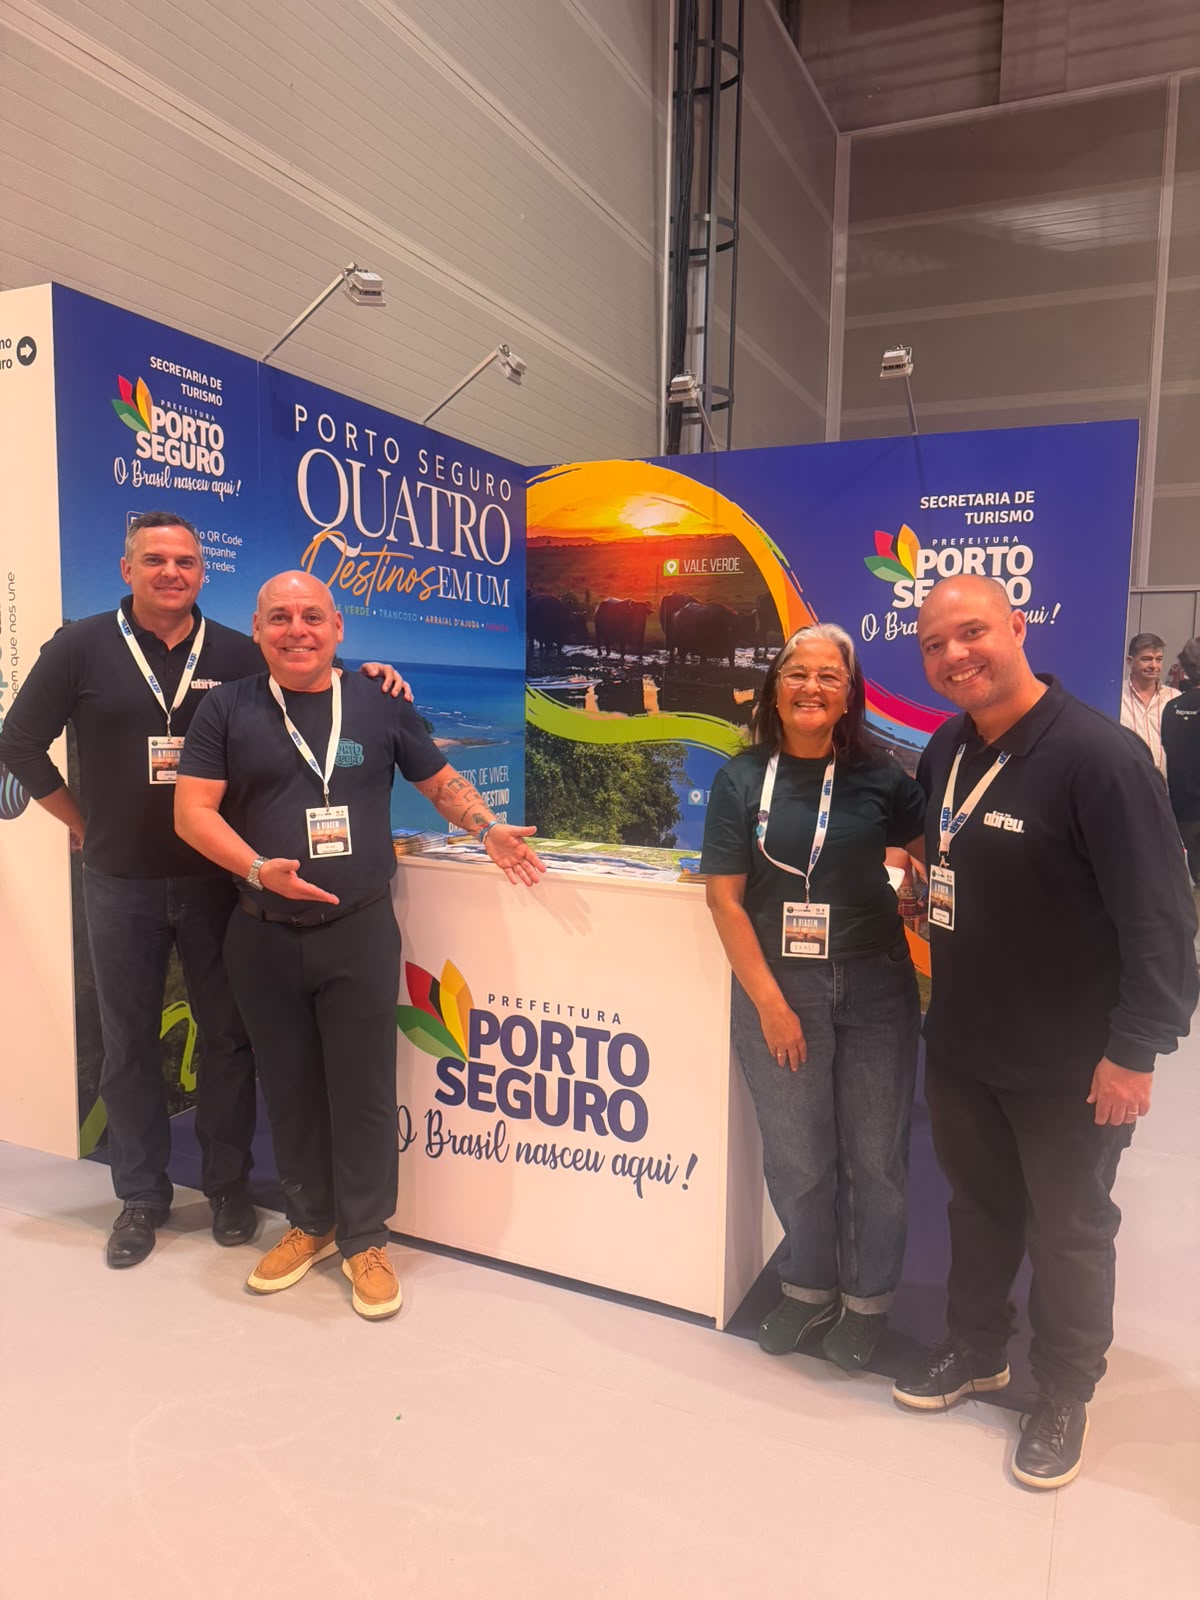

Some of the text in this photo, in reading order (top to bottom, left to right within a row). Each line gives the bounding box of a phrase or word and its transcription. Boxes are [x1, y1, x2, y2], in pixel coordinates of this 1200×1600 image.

[150, 356, 223, 390] SECRETARIA DE
[181, 383, 223, 406] TURISMO
[160, 399, 216, 421] PREFEITURA
[151, 405, 224, 451] PORTO
[136, 430, 225, 477] SEGURO
[295, 403, 512, 501] PORTO SEGURO
[114, 457, 129, 485] O
[131, 459, 173, 489] Brasil
[174, 476, 211, 492] nasceu
[297, 448, 511, 566] QUATRO
[920, 490, 1035, 509] SECRETARIA DE
[965, 509, 1034, 525] TURISMO
[207, 530, 220, 543] QR
[221, 533, 243, 546] Code
[932, 535, 1019, 547] PREFEITURA
[212, 561, 236, 573] redes
[301, 531, 511, 608] Destinos EM UM
[683, 557, 740, 573] VALE VERDE
[915, 544, 1034, 579] PORTO
[8, 571, 16, 601] une
[9, 605, 17, 633] nos
[861, 613, 881, 642] O
[10, 637, 20, 667] que
[479, 767, 488, 786] DE
[489, 764, 510, 784] VIVER
[488, 993, 622, 1025] PREFEITURA
[469, 1008, 650, 1088] PORTO
[434, 1056, 649, 1143] SEGURO
[424, 1108, 510, 1163] Brasil
[515, 1140, 606, 1173] nasceu
